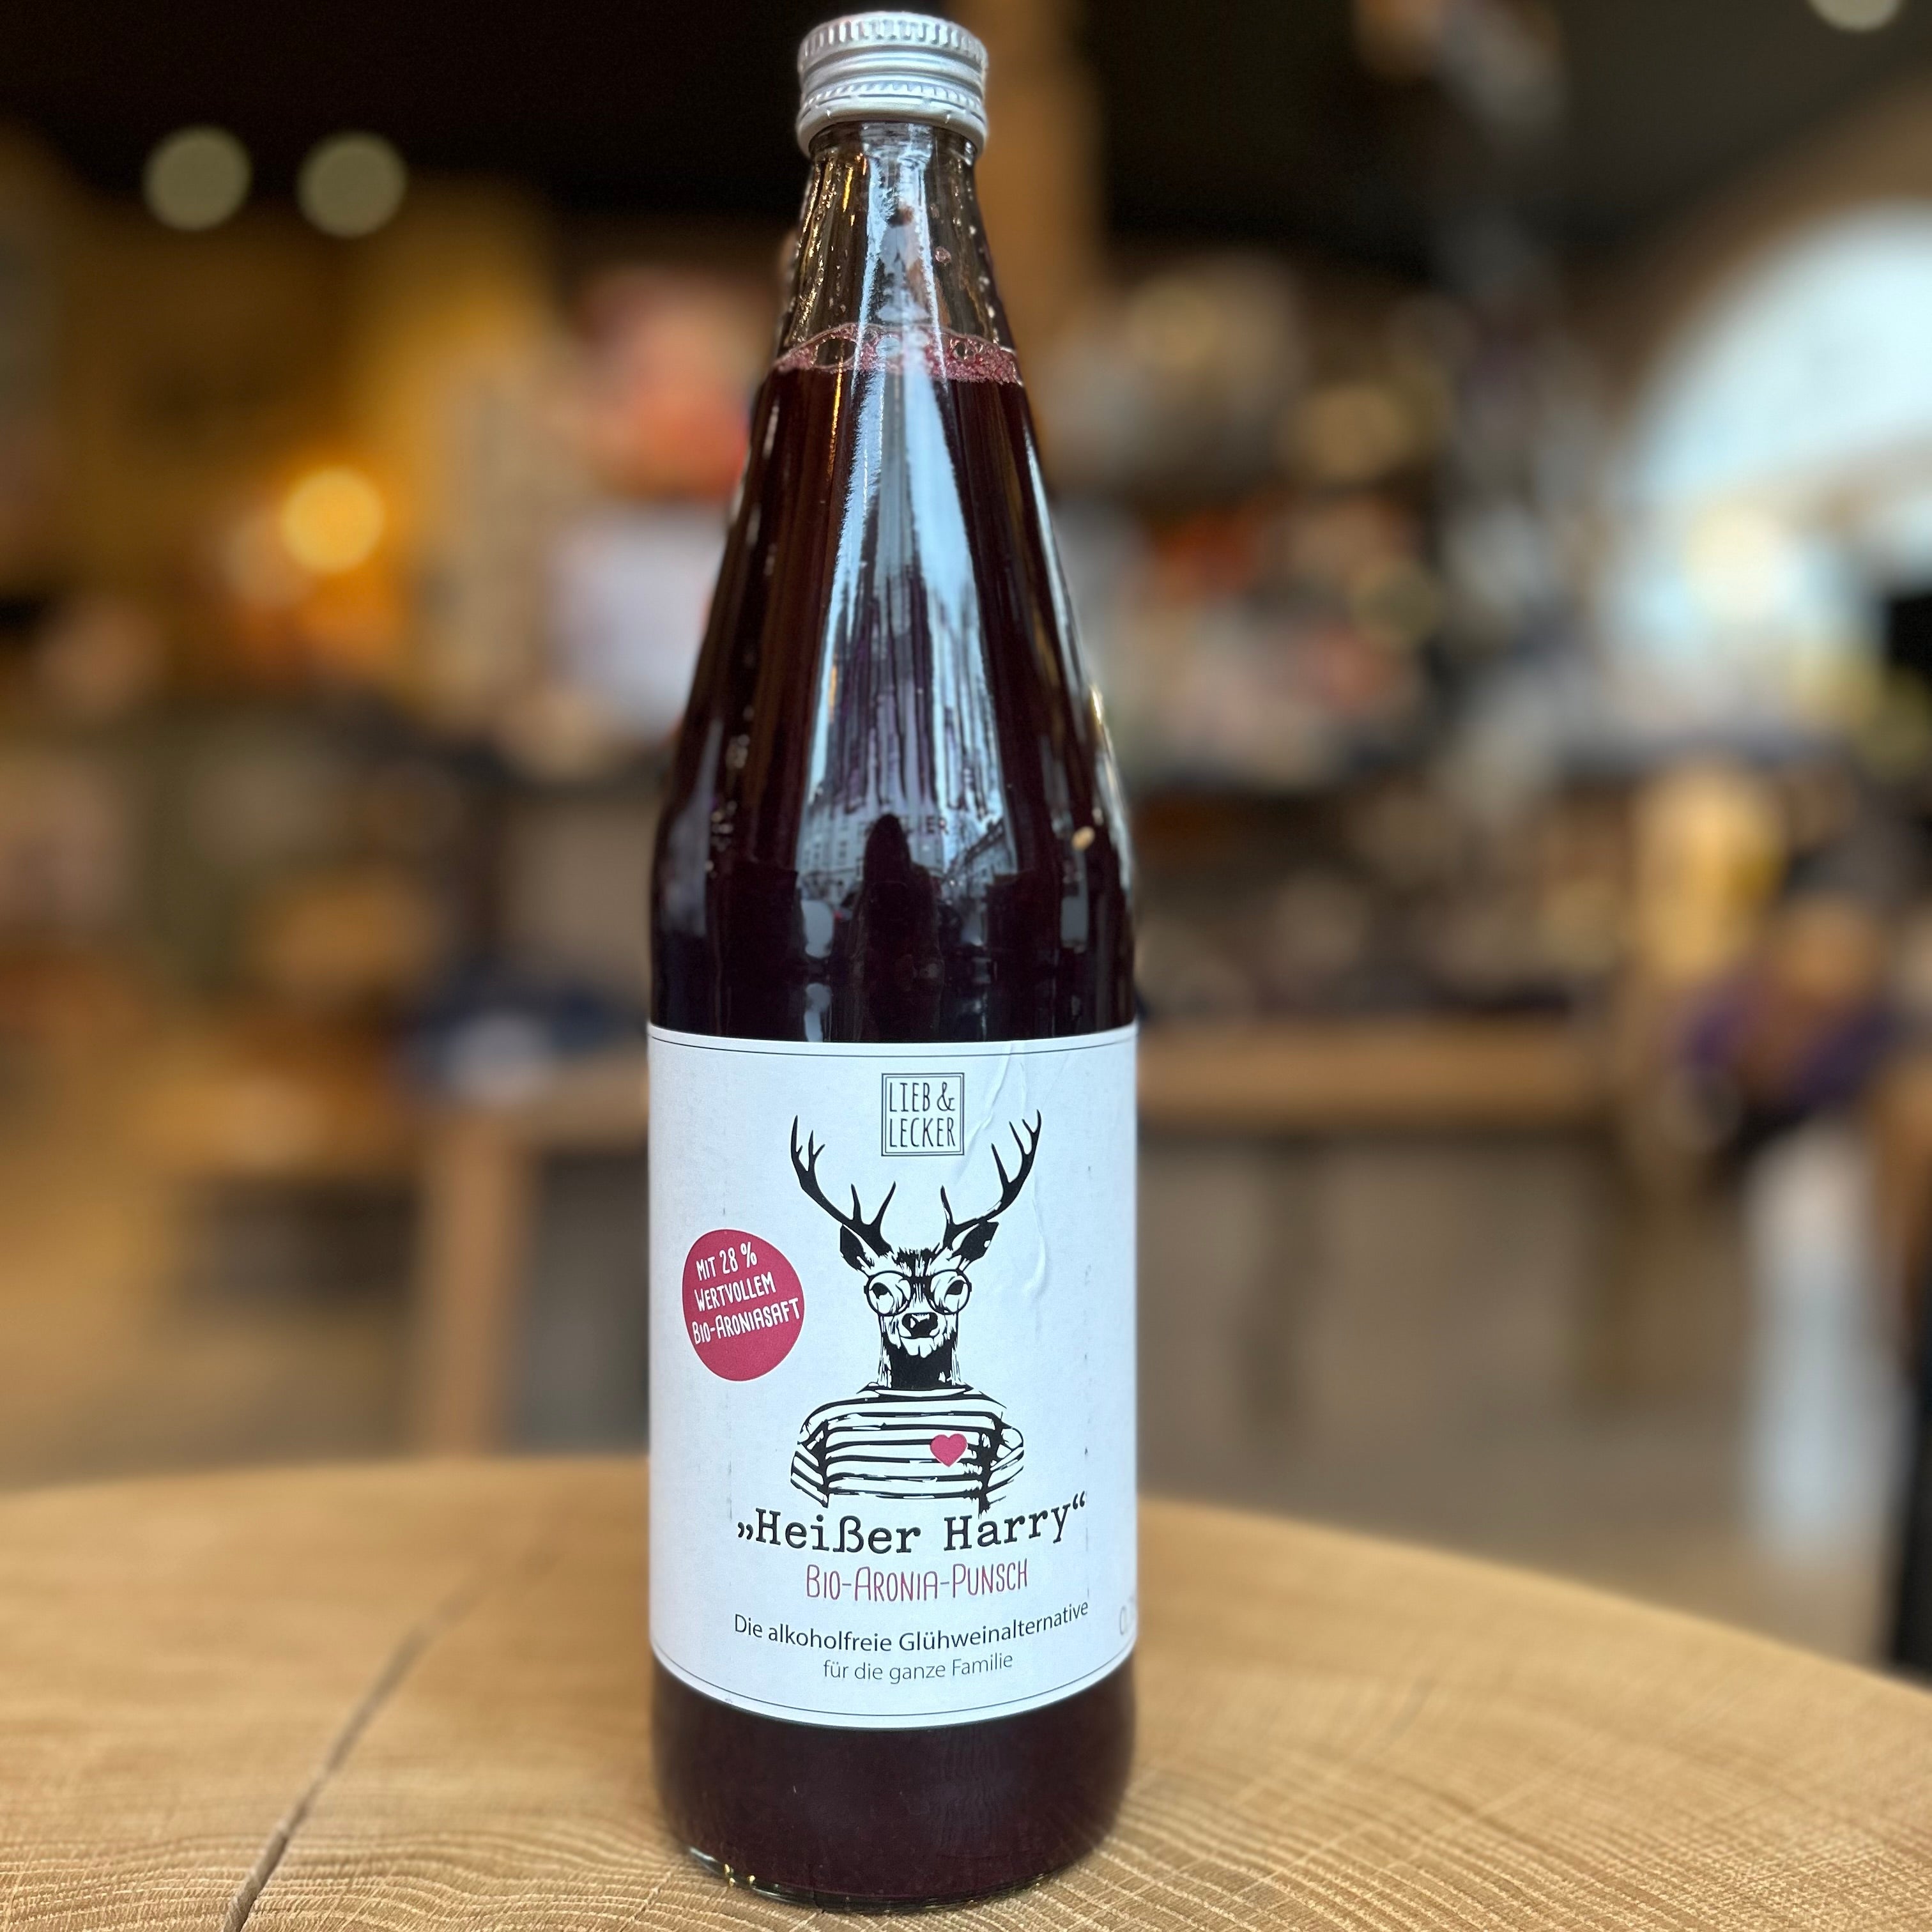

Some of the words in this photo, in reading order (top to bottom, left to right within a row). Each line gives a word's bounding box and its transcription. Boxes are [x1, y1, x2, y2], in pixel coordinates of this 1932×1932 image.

[889, 1082, 931, 1112] LIEB
[937, 1082, 955, 1112] &
[889, 1117, 956, 1148] LECKER
[696, 1257, 716, 1280] MIT
[719, 1248, 738, 1274] 28
[740, 1241, 758, 1268] %
[694, 1271, 776, 1312] WERTVOLLEM
[692, 1298, 800, 1344] BIO-ARONIASAFT
[807, 1558, 1027, 1602] BIO-ARONIA-PUNSCH
[735, 1614, 762, 1638] Die
[768, 1623, 893, 1652] alkoholfreie
[899, 1600, 1089, 1652] Glühweinalternative
[824, 1660, 848, 1678] für
[855, 1662, 882, 1680] die
[889, 1665, 945, 1684] ganze
[953, 1653, 1013, 1676] Familie
